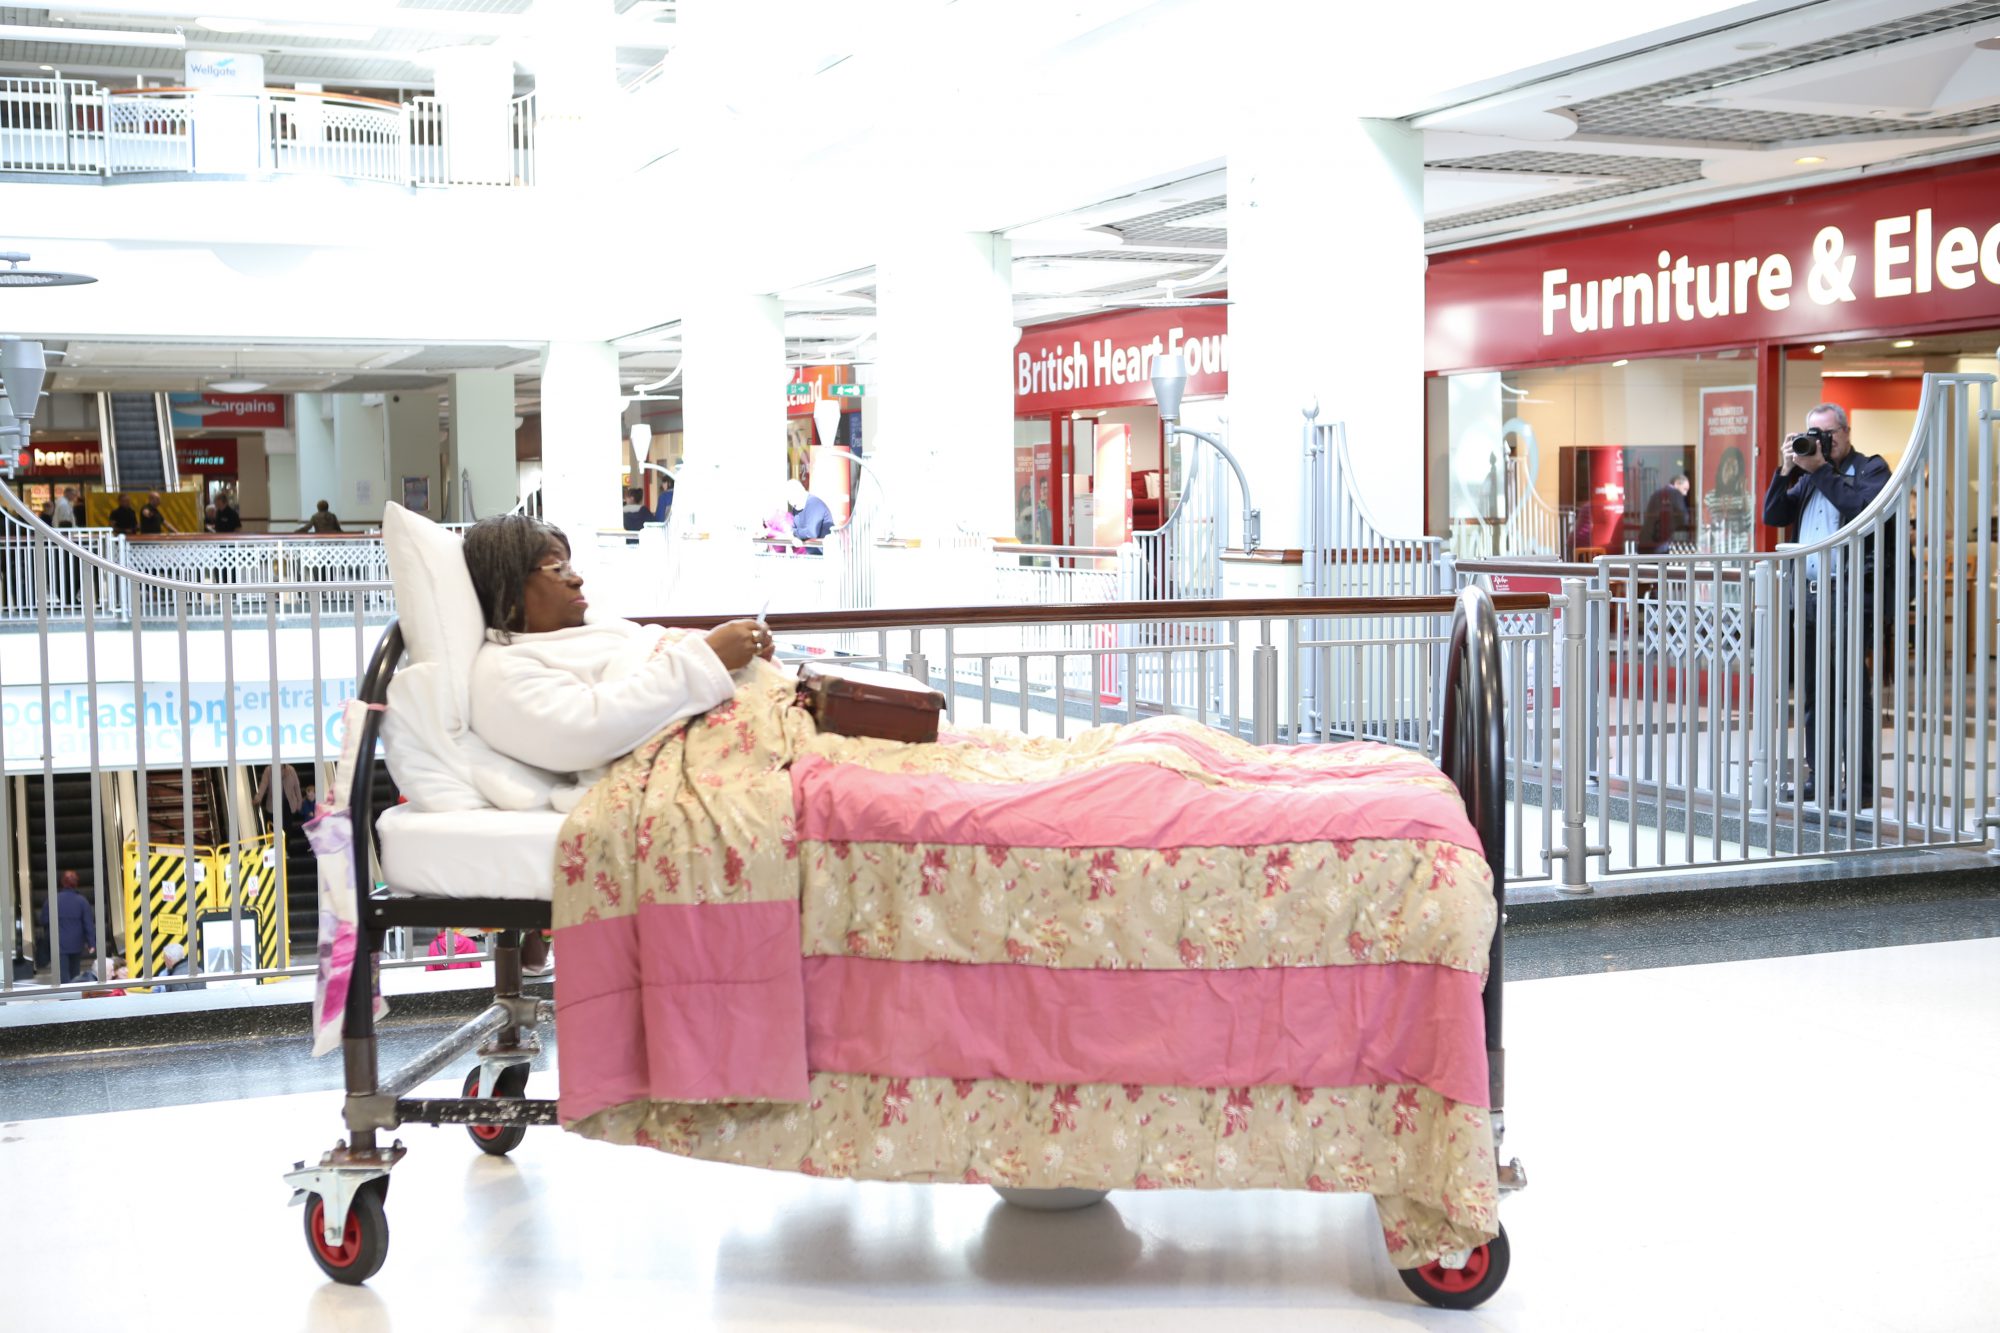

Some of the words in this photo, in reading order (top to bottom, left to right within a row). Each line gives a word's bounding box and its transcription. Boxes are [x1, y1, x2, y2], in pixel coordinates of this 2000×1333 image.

[190, 63, 236, 77] Wellgate
[1541, 249, 1793, 336] Furniture
[1806, 225, 1857, 306] &
[1873, 207, 2000, 299] Elec
[1018, 340, 1088, 396] British
[1093, 335, 1163, 387] Heart
[34, 448, 104, 469] bargain
[76, 690, 228, 729] Fashion
[213, 719, 316, 748] Home
